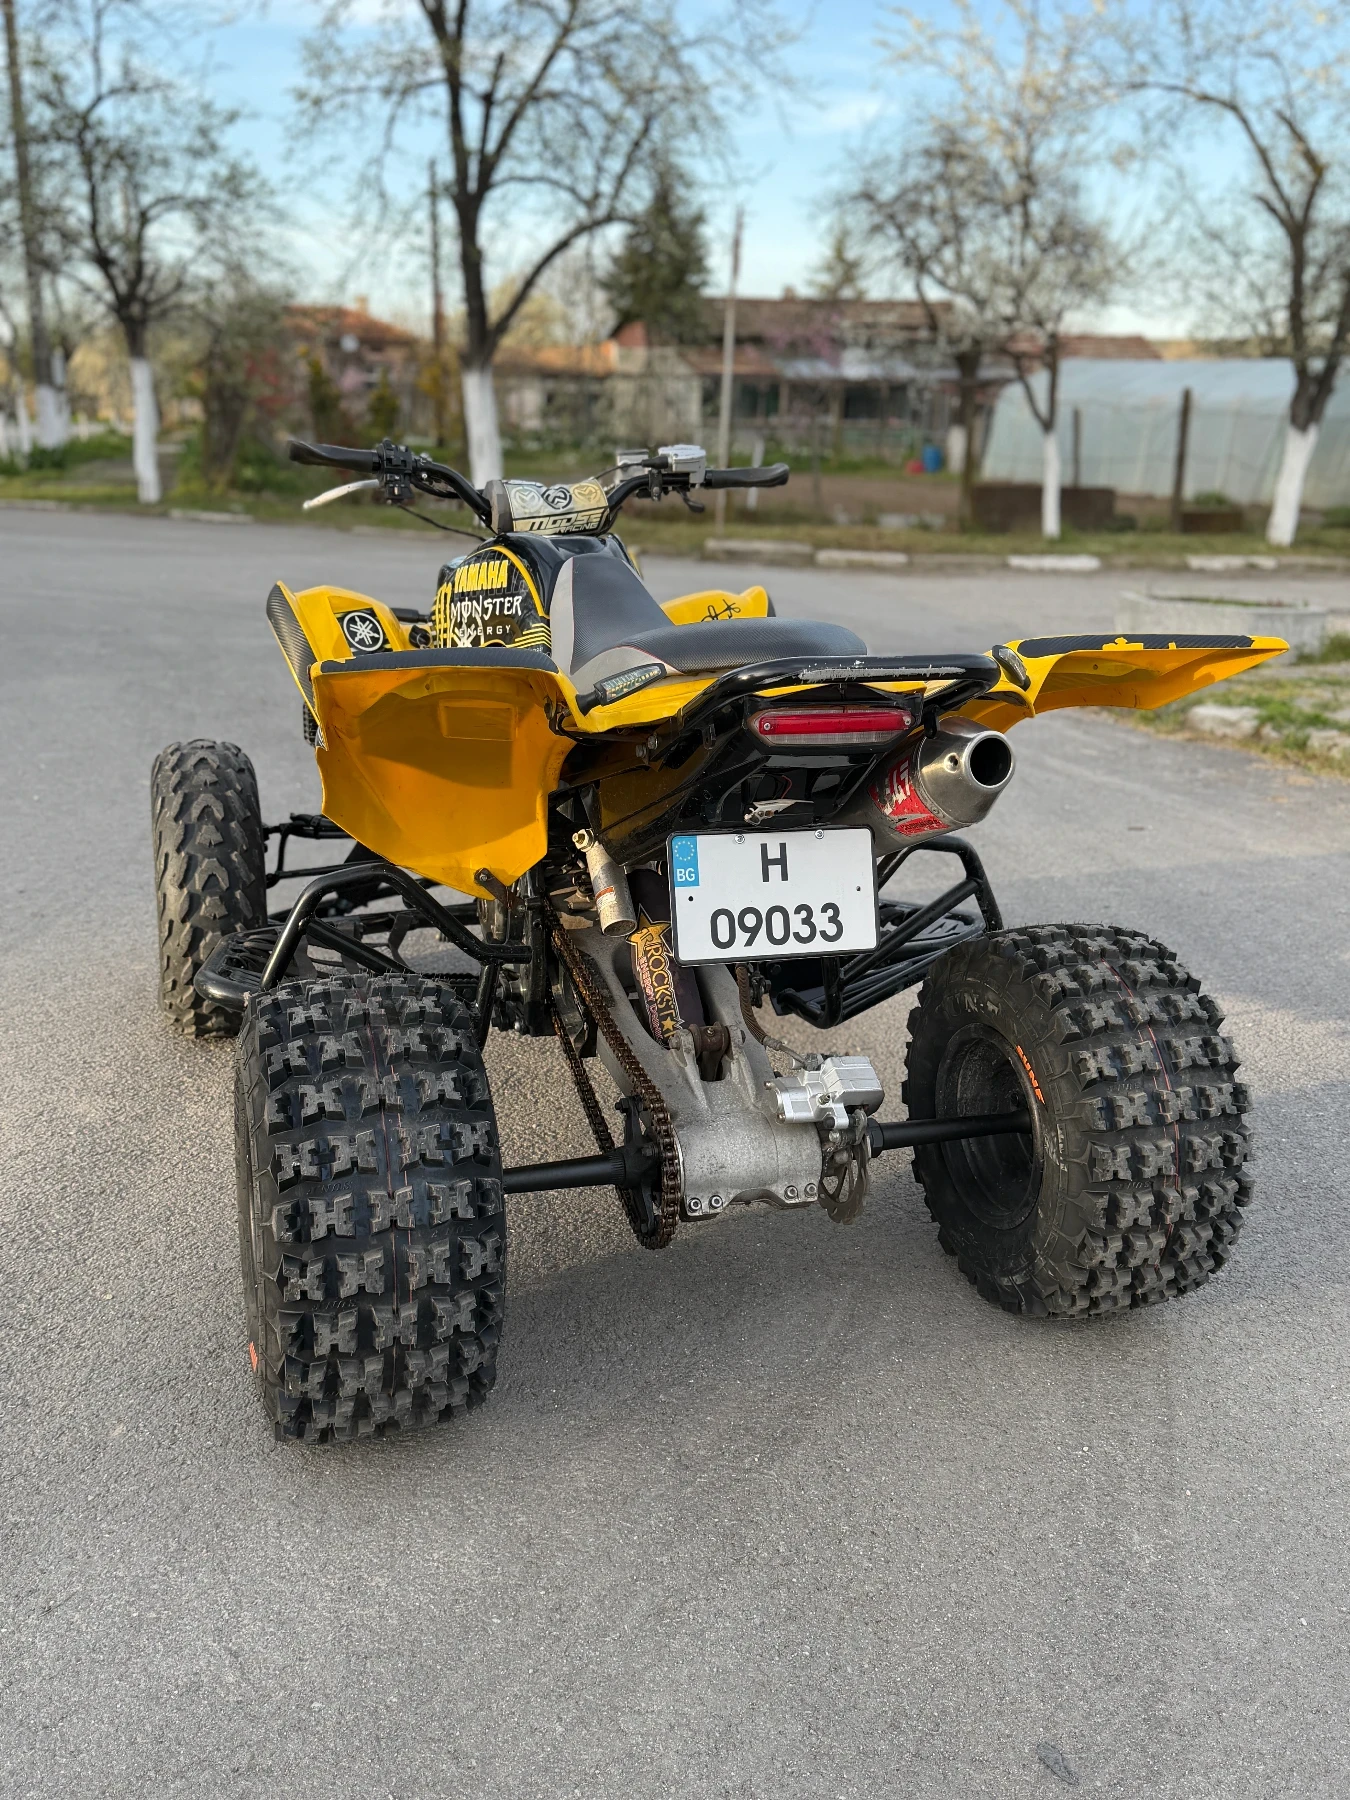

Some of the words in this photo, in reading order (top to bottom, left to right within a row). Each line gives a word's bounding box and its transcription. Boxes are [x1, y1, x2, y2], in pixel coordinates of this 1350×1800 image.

[528, 511, 601, 532] MOOSE
[558, 522, 598, 533] RACING
[454, 560, 509, 593] YAMAHA
[450, 595, 523, 623] MONSTER
[459, 624, 511, 637] ENERGY
[760, 842, 789, 882] H
[676, 867, 696, 882] BG
[710, 902, 844, 949] 09033
